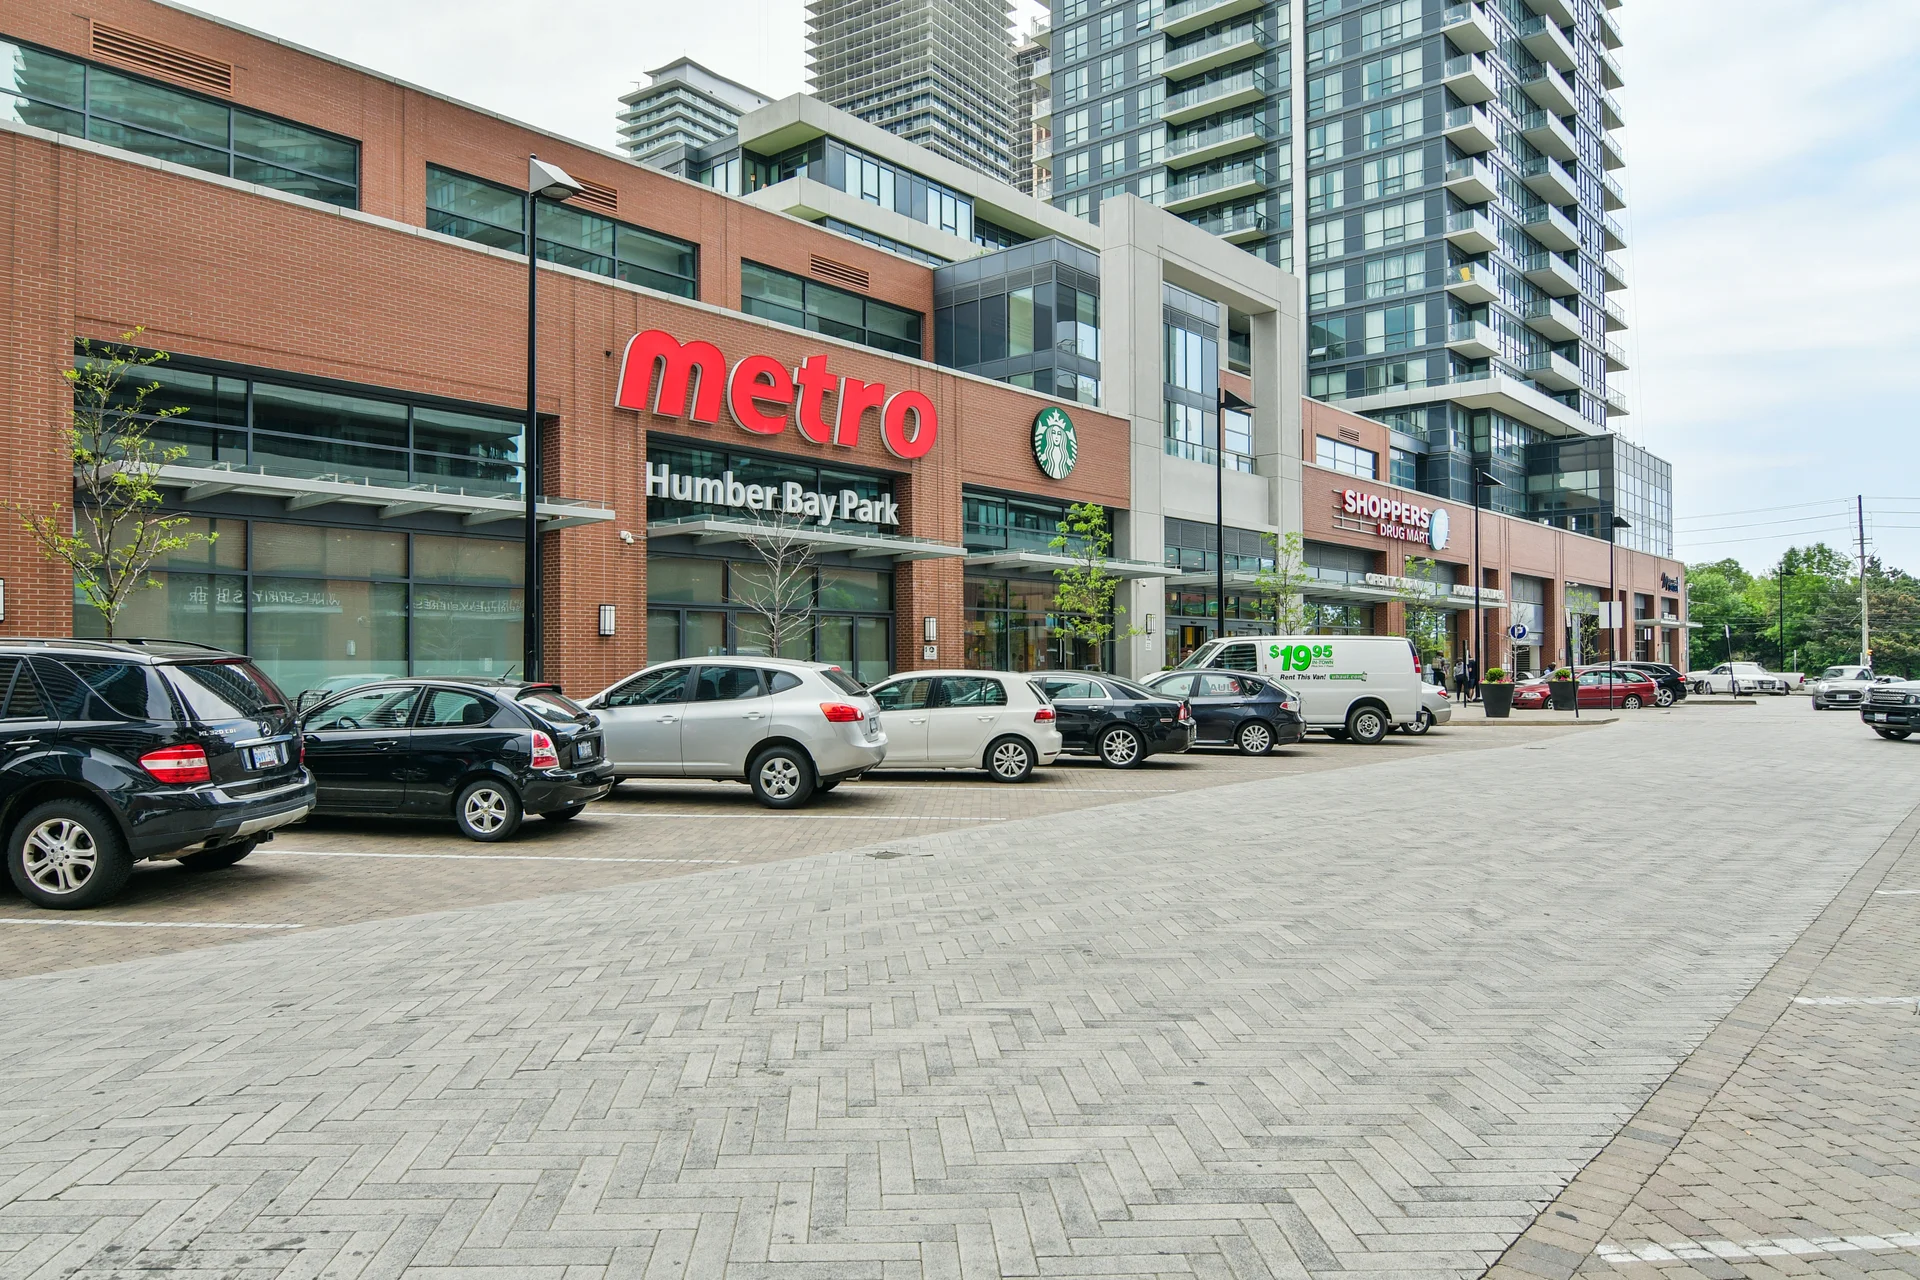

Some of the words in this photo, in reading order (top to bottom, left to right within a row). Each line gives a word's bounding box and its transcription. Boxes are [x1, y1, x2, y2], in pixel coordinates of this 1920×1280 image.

[615, 329, 938, 459] metro
[646, 462, 778, 511] Humber
[782, 481, 837, 526] Bay
[839, 489, 899, 526] Park
[1342, 489, 1430, 529] SHOPPERS
[1378, 523, 1405, 540] DRUG
[1405, 528, 1430, 545] MART
